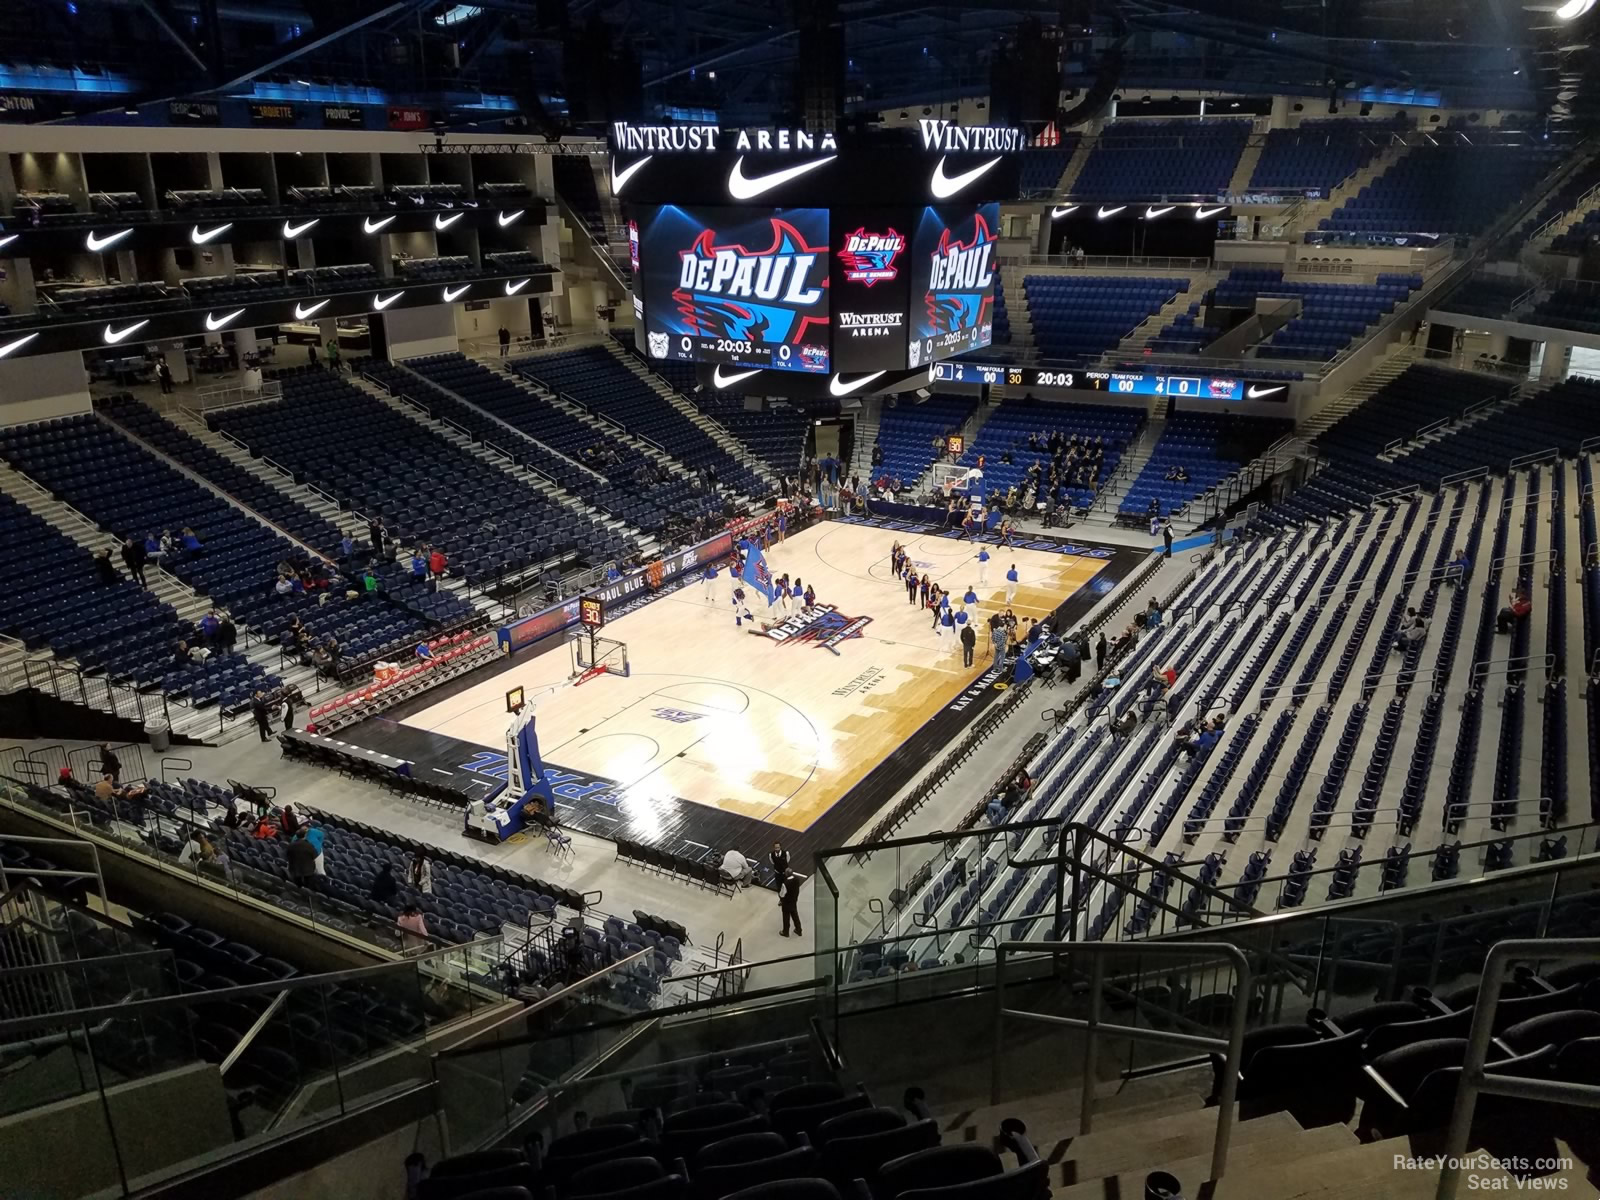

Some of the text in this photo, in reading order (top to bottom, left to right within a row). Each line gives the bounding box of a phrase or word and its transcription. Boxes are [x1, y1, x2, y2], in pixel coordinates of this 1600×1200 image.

[614, 122, 838, 151] WINTRUST ARENA
[919, 119, 1018, 152] WINTRUST
[839, 312, 903, 325] WINTRUST
[852, 328, 889, 337] ARENA
[681, 336, 692, 352] 0
[717, 339, 752, 354] 20:03
[779, 345, 791, 360] 0
[955, 370, 964, 380] 4
[984, 372, 996, 383] 00
[1009, 374, 1022, 385] 30
[1037, 372, 1074, 386] 20:03
[1094, 379, 1100, 389] 1
[1118, 380, 1134, 392] 00
[1155, 383, 1164, 394] 4
[1179, 381, 1188, 393] 0
[624, 575, 645, 594] BLUE
[831, 665, 881, 697] WINTRUST
[860, 674, 886, 694] ARENA
[950, 695, 974, 711] RAY
